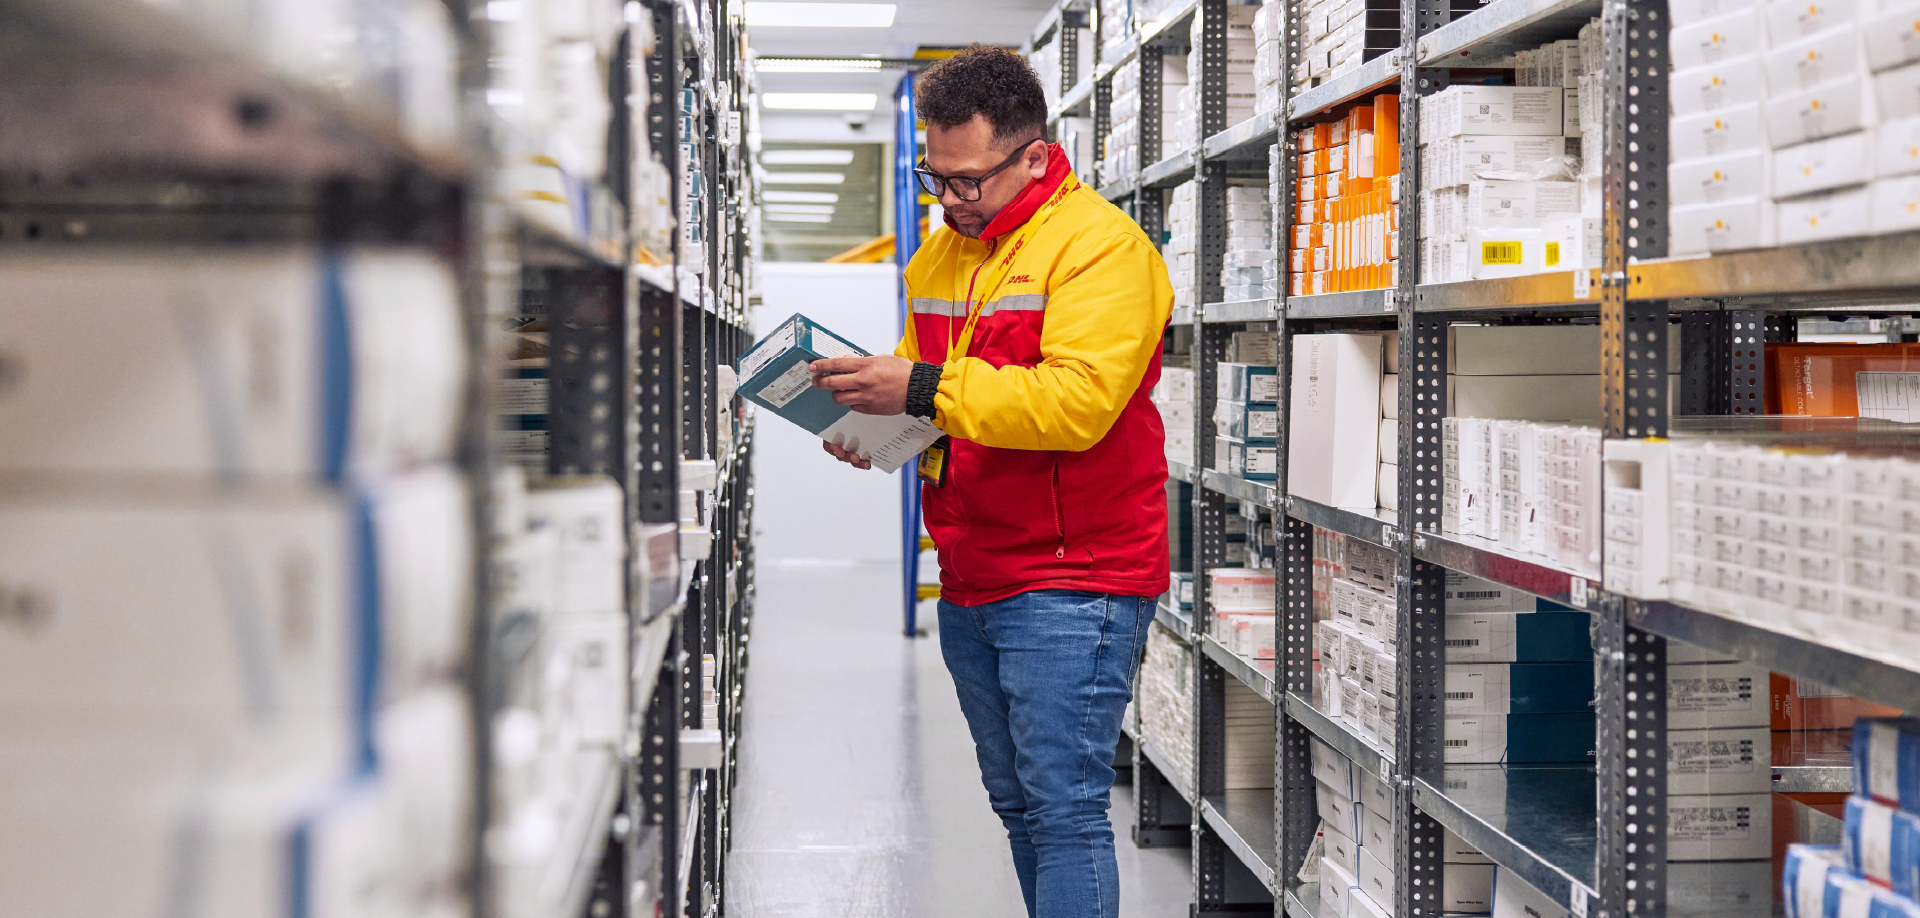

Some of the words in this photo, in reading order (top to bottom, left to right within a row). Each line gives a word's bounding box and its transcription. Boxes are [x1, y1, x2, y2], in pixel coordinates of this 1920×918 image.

[1045, 183, 1069, 209] DHL
[1000, 234, 1025, 268] DHL
[1006, 274, 1033, 285] DHL
[966, 294, 985, 332] DHL
